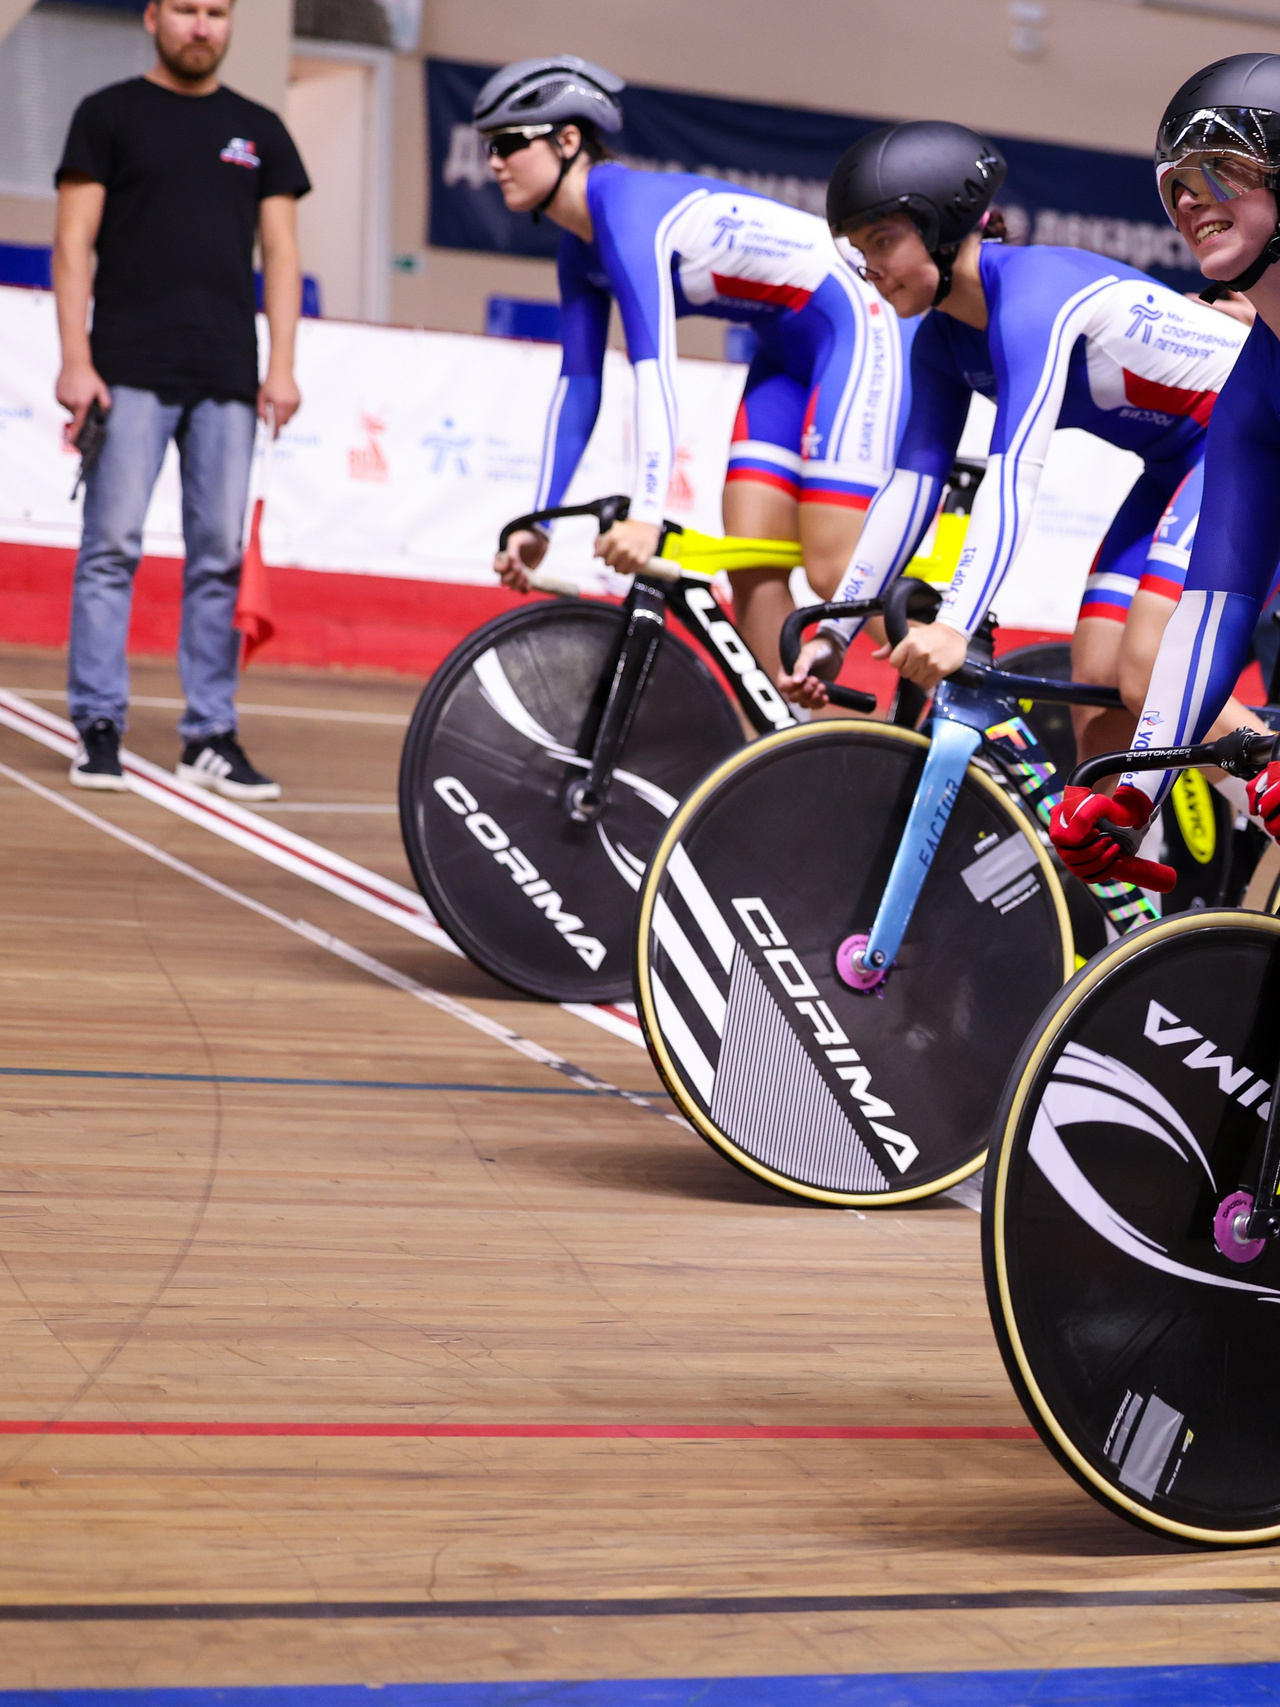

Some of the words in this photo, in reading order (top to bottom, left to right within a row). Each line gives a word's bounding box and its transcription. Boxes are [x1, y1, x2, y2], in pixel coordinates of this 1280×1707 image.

[1152, 338, 1216, 360] ПЕТЕРБУРГ
[1161, 324, 1242, 350] СПОРТИВНЫЙ
[1126, 748, 1192, 758] CUSTOMIZER
[919, 778, 959, 869] FACTOR
[432, 775, 607, 972] CORIMA
[731, 897, 920, 1174] CORIMA
